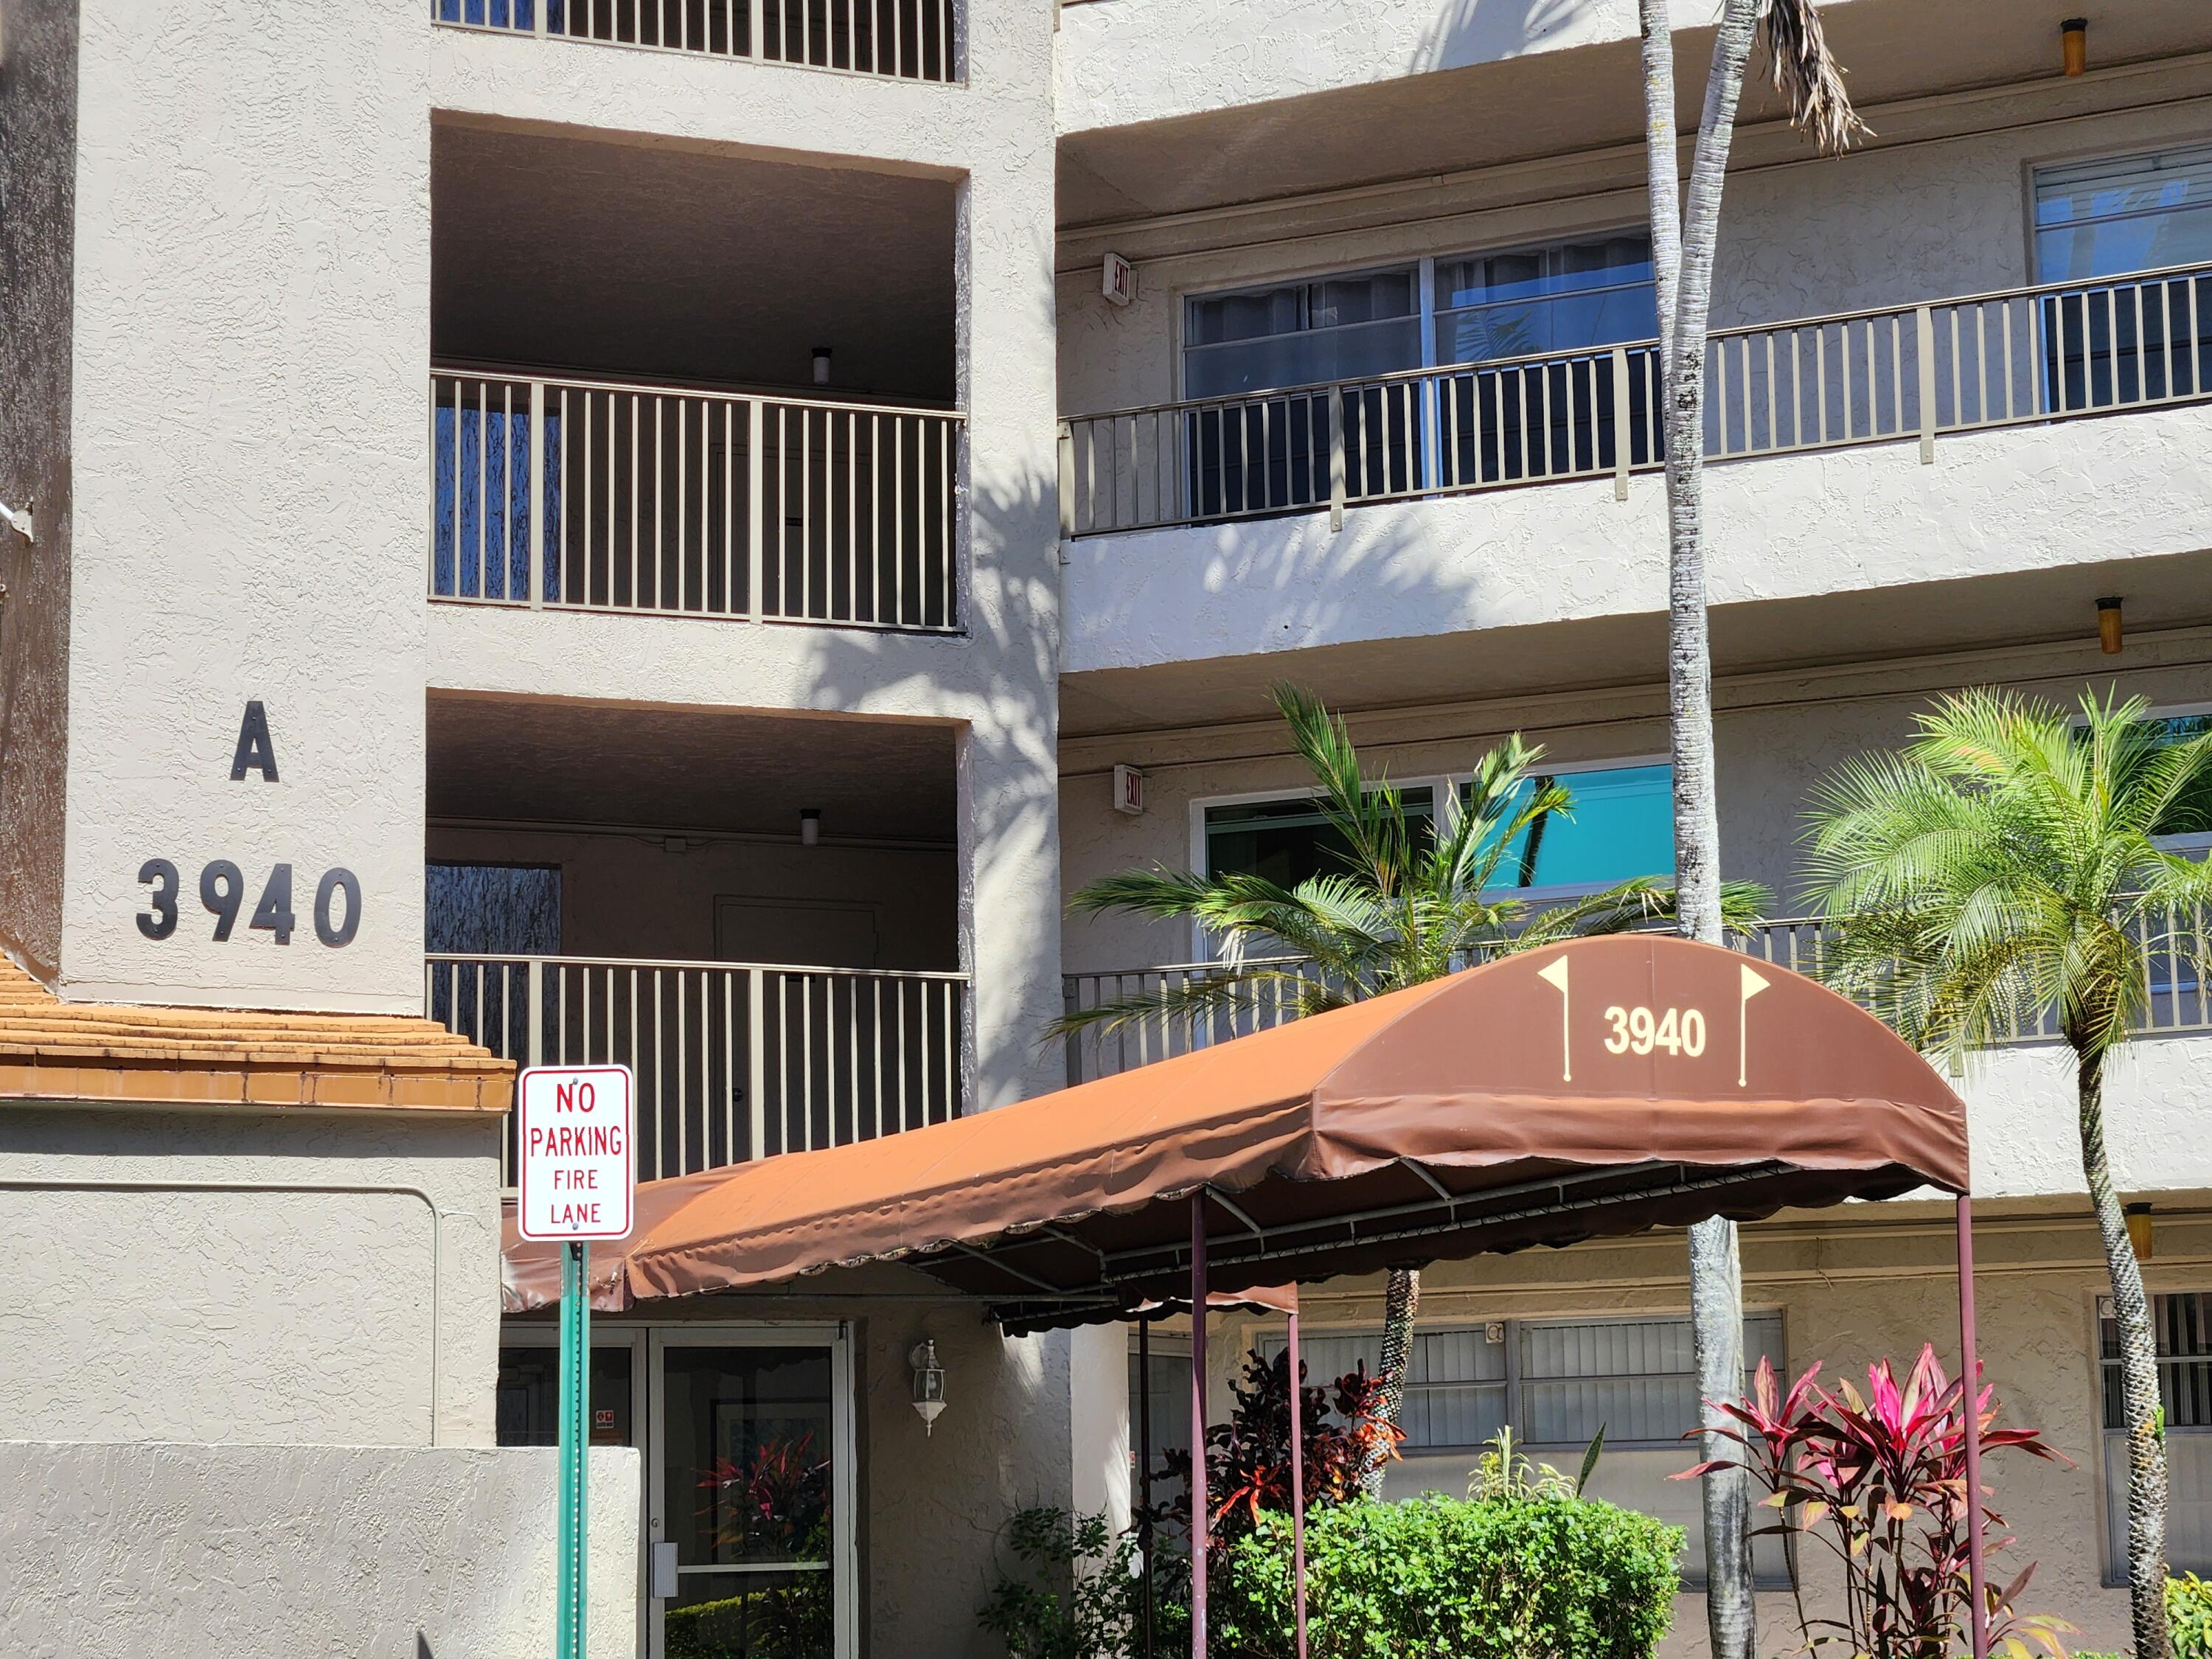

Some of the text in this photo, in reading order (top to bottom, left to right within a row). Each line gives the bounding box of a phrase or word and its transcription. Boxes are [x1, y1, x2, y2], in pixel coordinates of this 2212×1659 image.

[229, 700, 279, 783] A
[136, 858, 362, 948] 3940
[1604, 1006, 1706, 1057] 3940
[557, 1082, 596, 1113] NO
[530, 1125, 622, 1157] PARKING
[554, 1169, 598, 1190] FIRE
[550, 1203, 602, 1224] LANE
